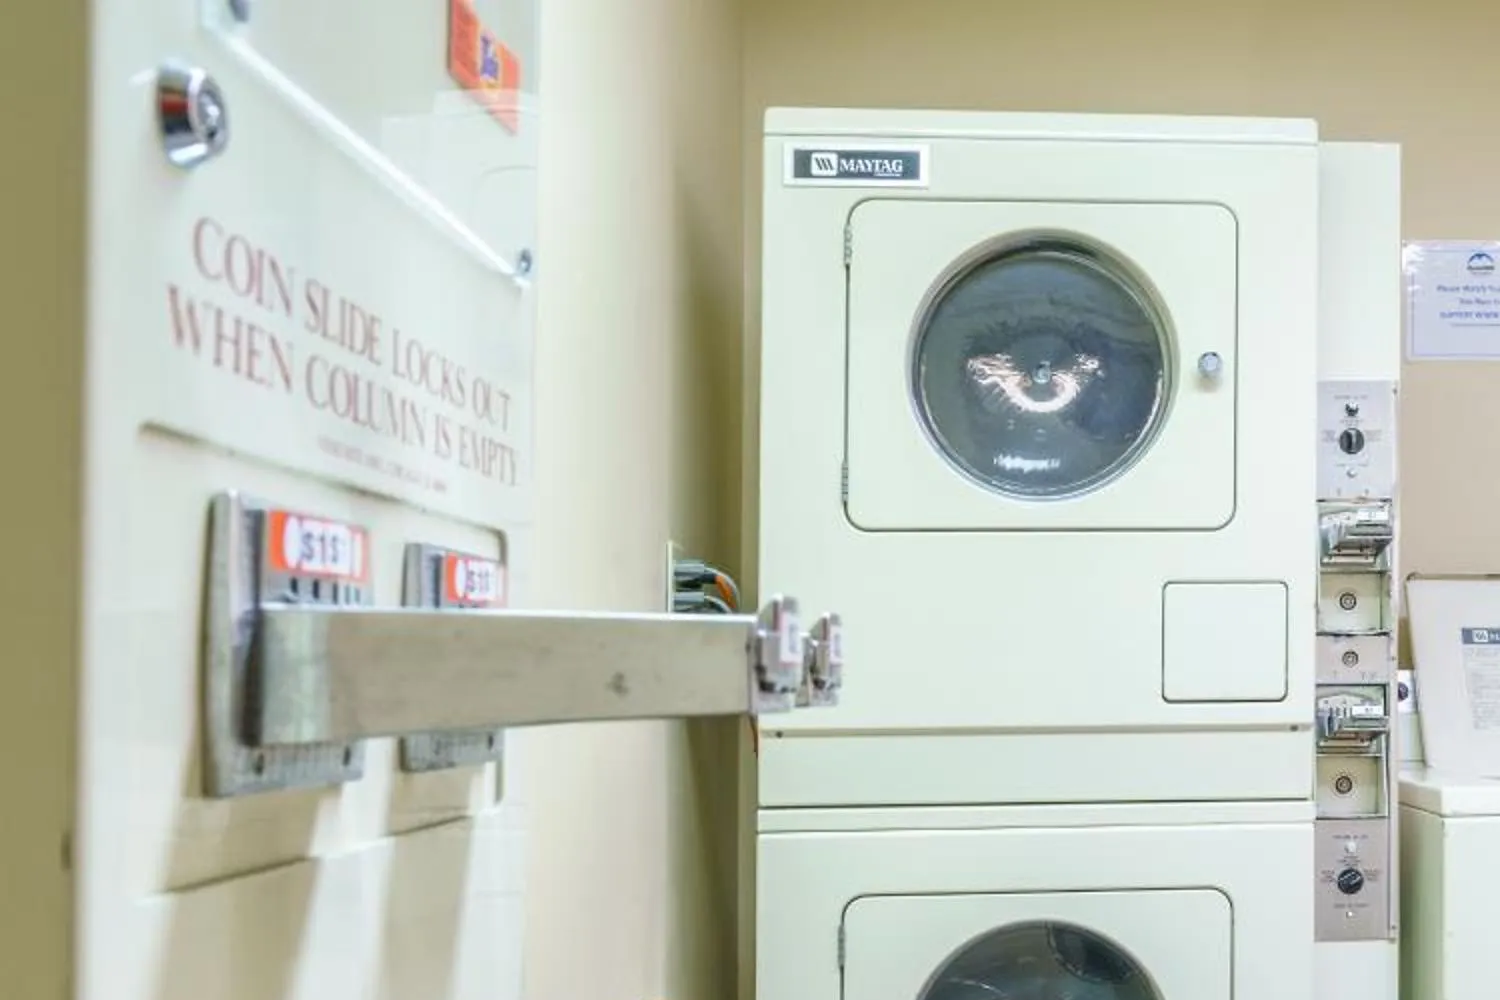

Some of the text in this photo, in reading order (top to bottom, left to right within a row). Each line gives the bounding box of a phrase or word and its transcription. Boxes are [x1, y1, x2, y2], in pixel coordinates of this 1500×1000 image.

[839, 158, 903, 173] MAYTAG
[166, 282, 295, 395] WHEN
[304, 353, 428, 448] COLUMN
[433, 412, 453, 460] IS
[458, 424, 519, 488] EMPTY
[192, 216, 512, 433] COIN SLIDE LOCKS OUT
